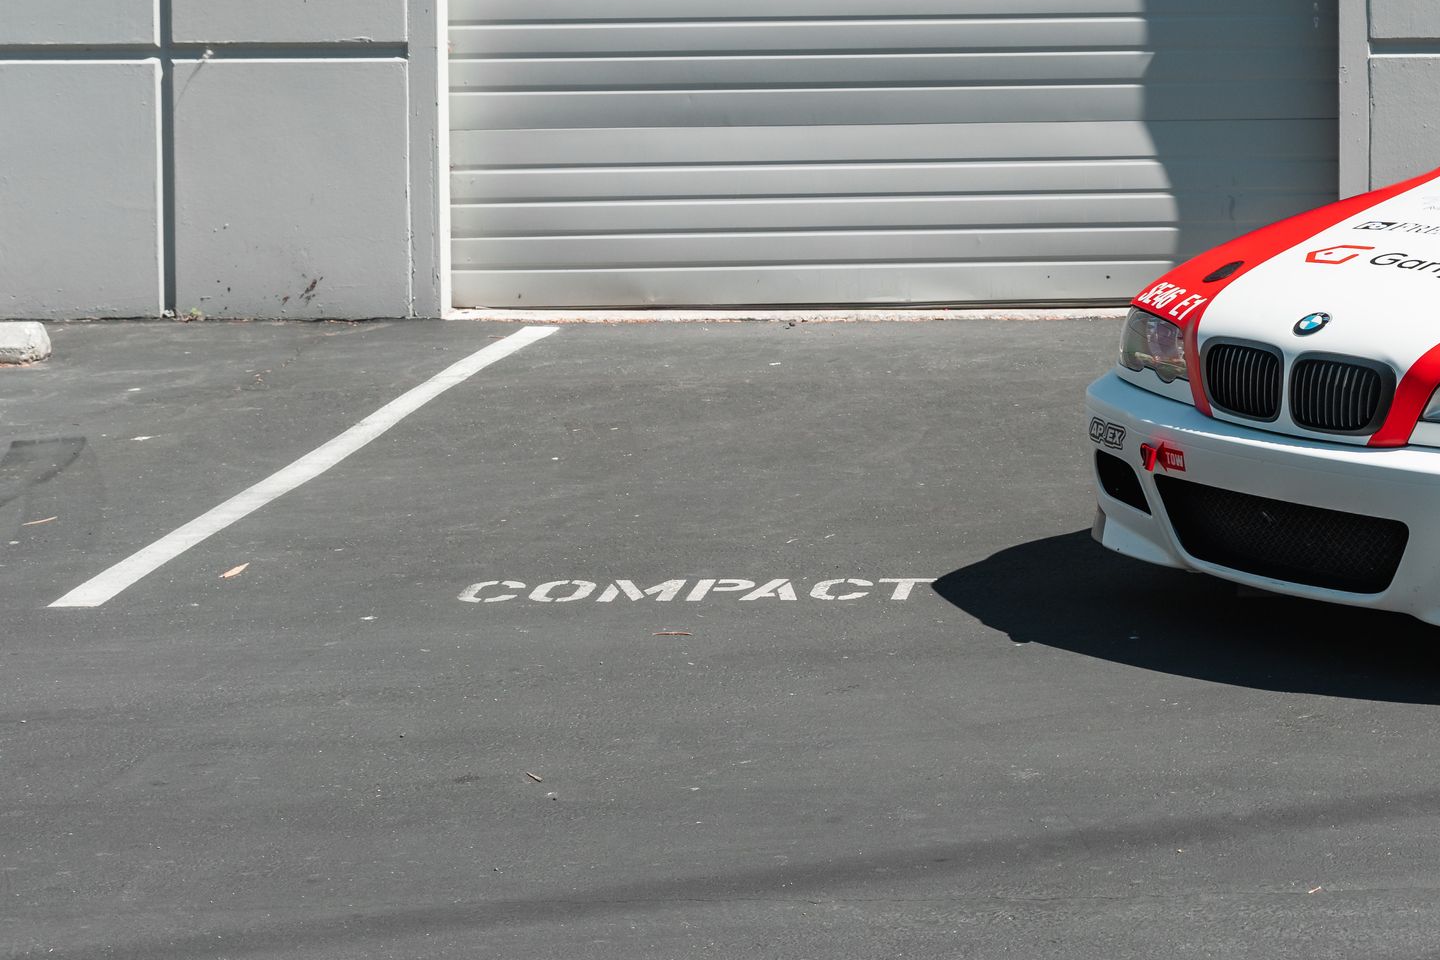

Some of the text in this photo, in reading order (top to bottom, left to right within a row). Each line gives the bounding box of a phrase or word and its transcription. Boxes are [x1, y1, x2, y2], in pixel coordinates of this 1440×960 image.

[1137, 282, 1208, 321] SE46 E1
[1091, 420, 1122, 445] APEX
[1165, 451, 1184, 468] TOW
[456, 577, 939, 603] COMPACT
